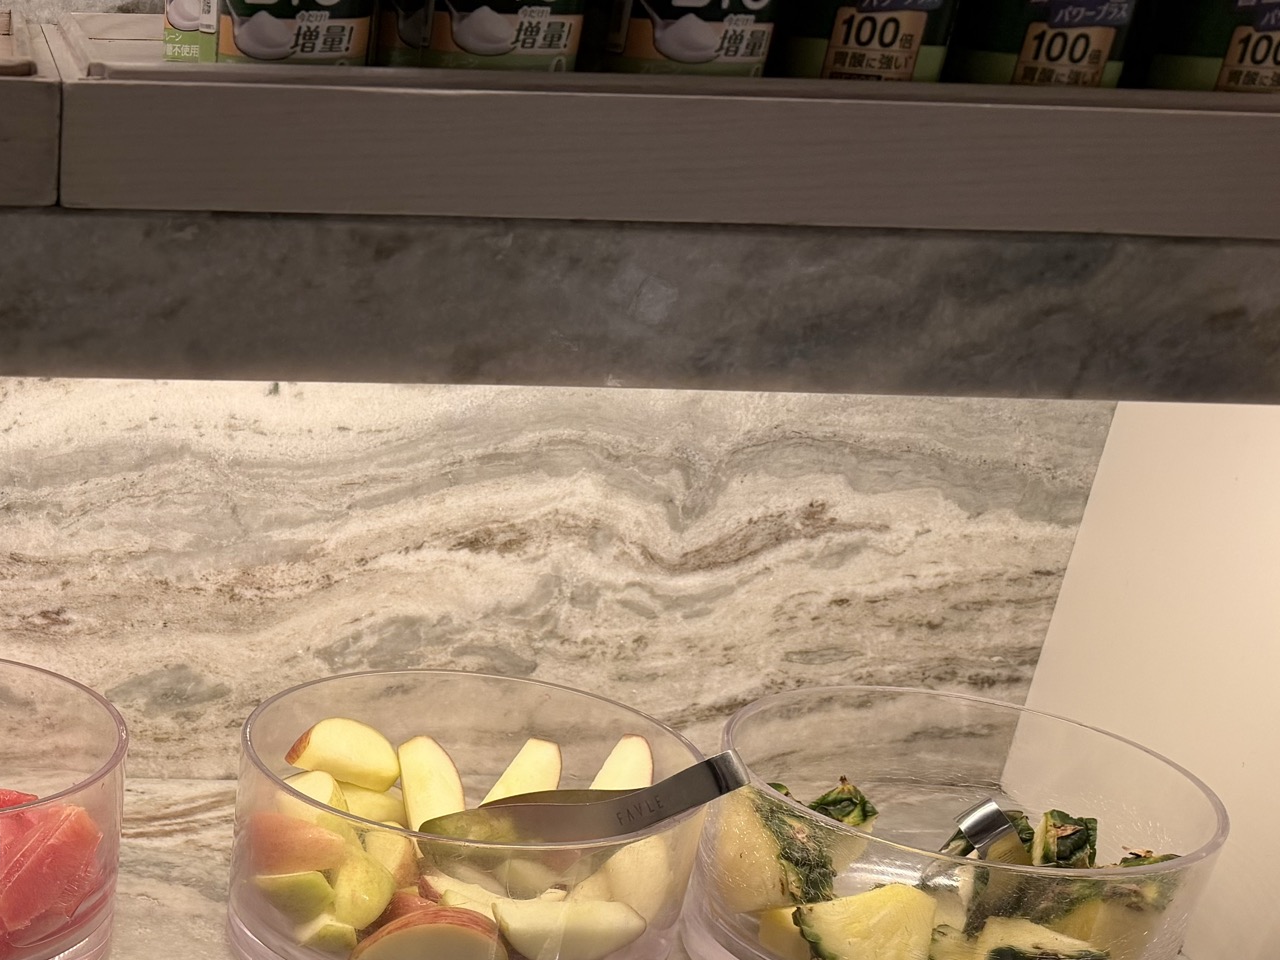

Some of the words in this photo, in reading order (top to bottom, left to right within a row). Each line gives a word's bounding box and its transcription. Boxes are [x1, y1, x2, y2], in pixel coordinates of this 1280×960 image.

[1053, 2, 1130, 23] パワープラス
[290, 25, 354, 53] 増量!
[511, 21, 573, 49] 増量!
